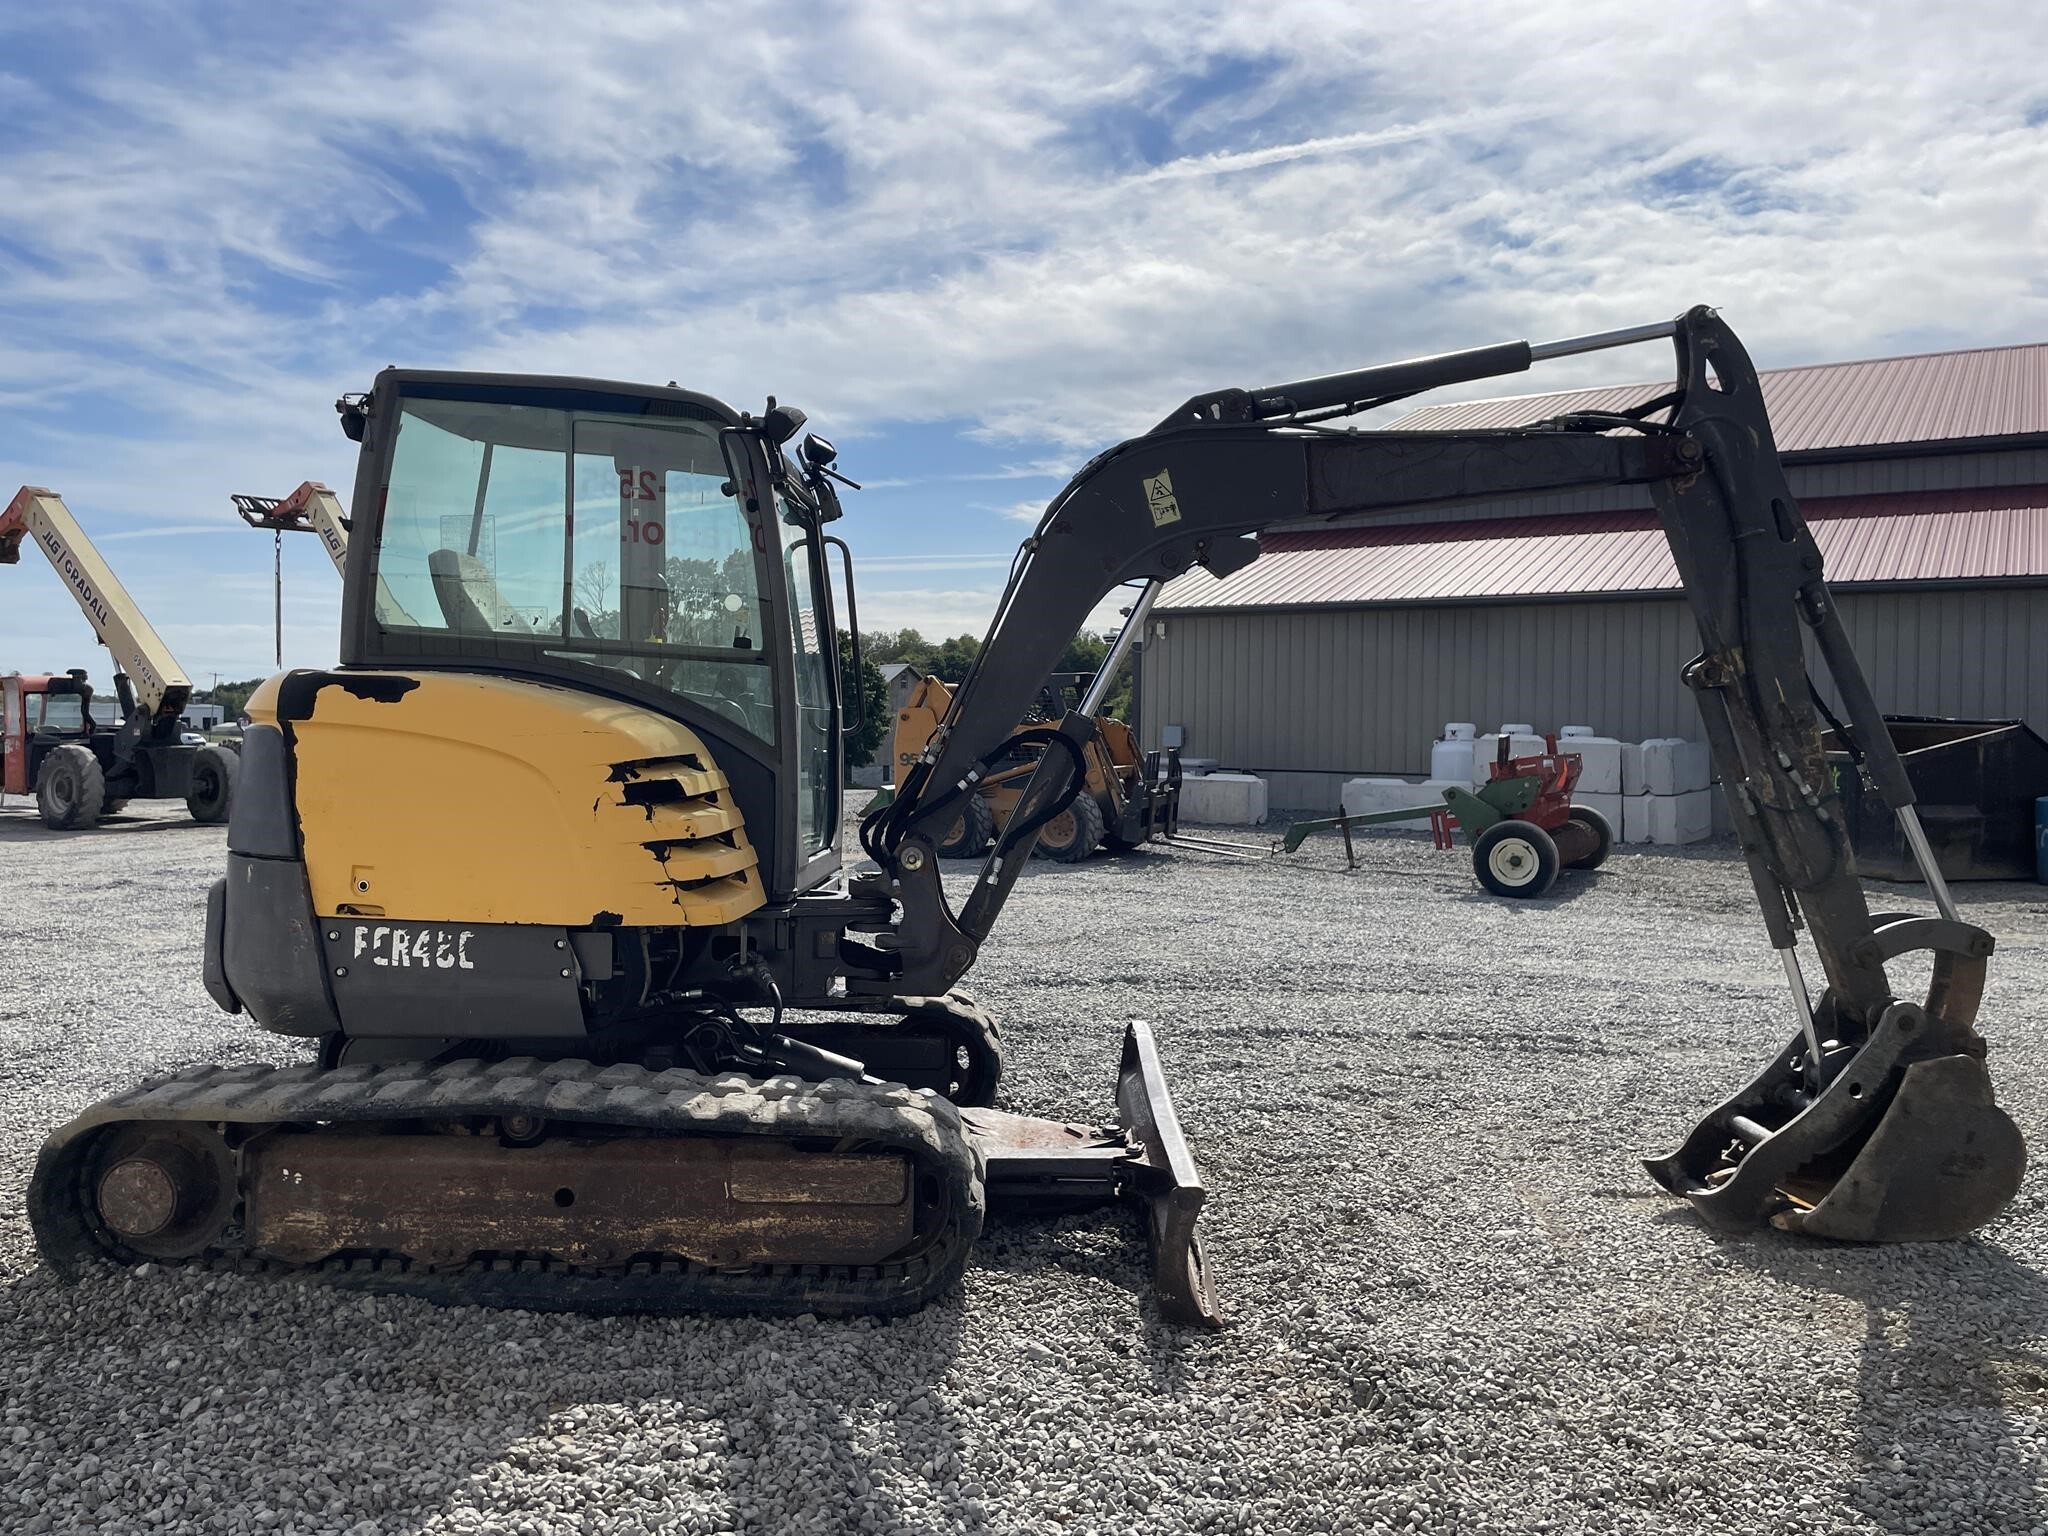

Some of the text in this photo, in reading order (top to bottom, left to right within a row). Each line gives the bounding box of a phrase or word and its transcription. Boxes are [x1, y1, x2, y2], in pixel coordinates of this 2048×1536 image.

[323, 528, 341, 551] JLG
[42, 530, 108, 627] JLG GRADALL
